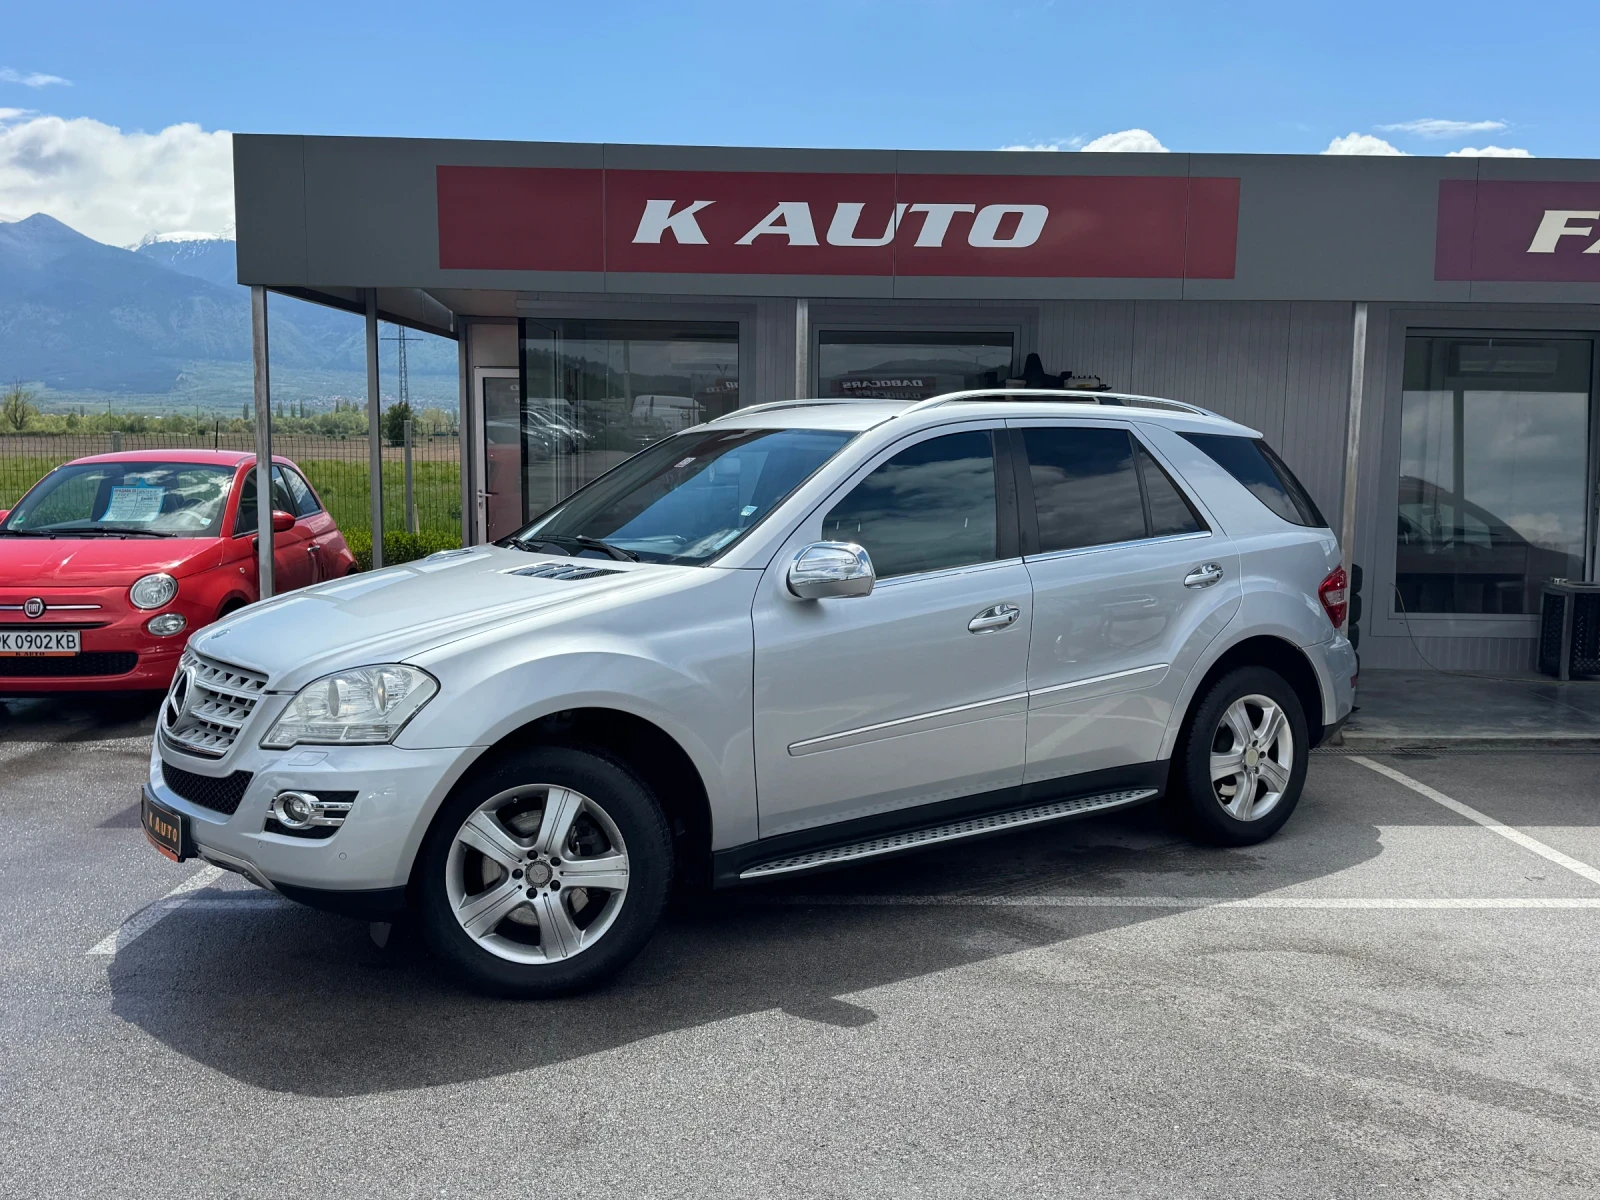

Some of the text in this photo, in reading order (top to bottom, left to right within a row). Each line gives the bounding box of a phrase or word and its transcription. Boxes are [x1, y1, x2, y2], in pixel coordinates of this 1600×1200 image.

[631, 199, 1049, 248] K AUTO
[1526, 210, 1600, 254] F
[28, 603, 39, 613] FIAT
[0, 634, 76, 650] K 0902 KB
[155, 816, 178, 842] AUTO
